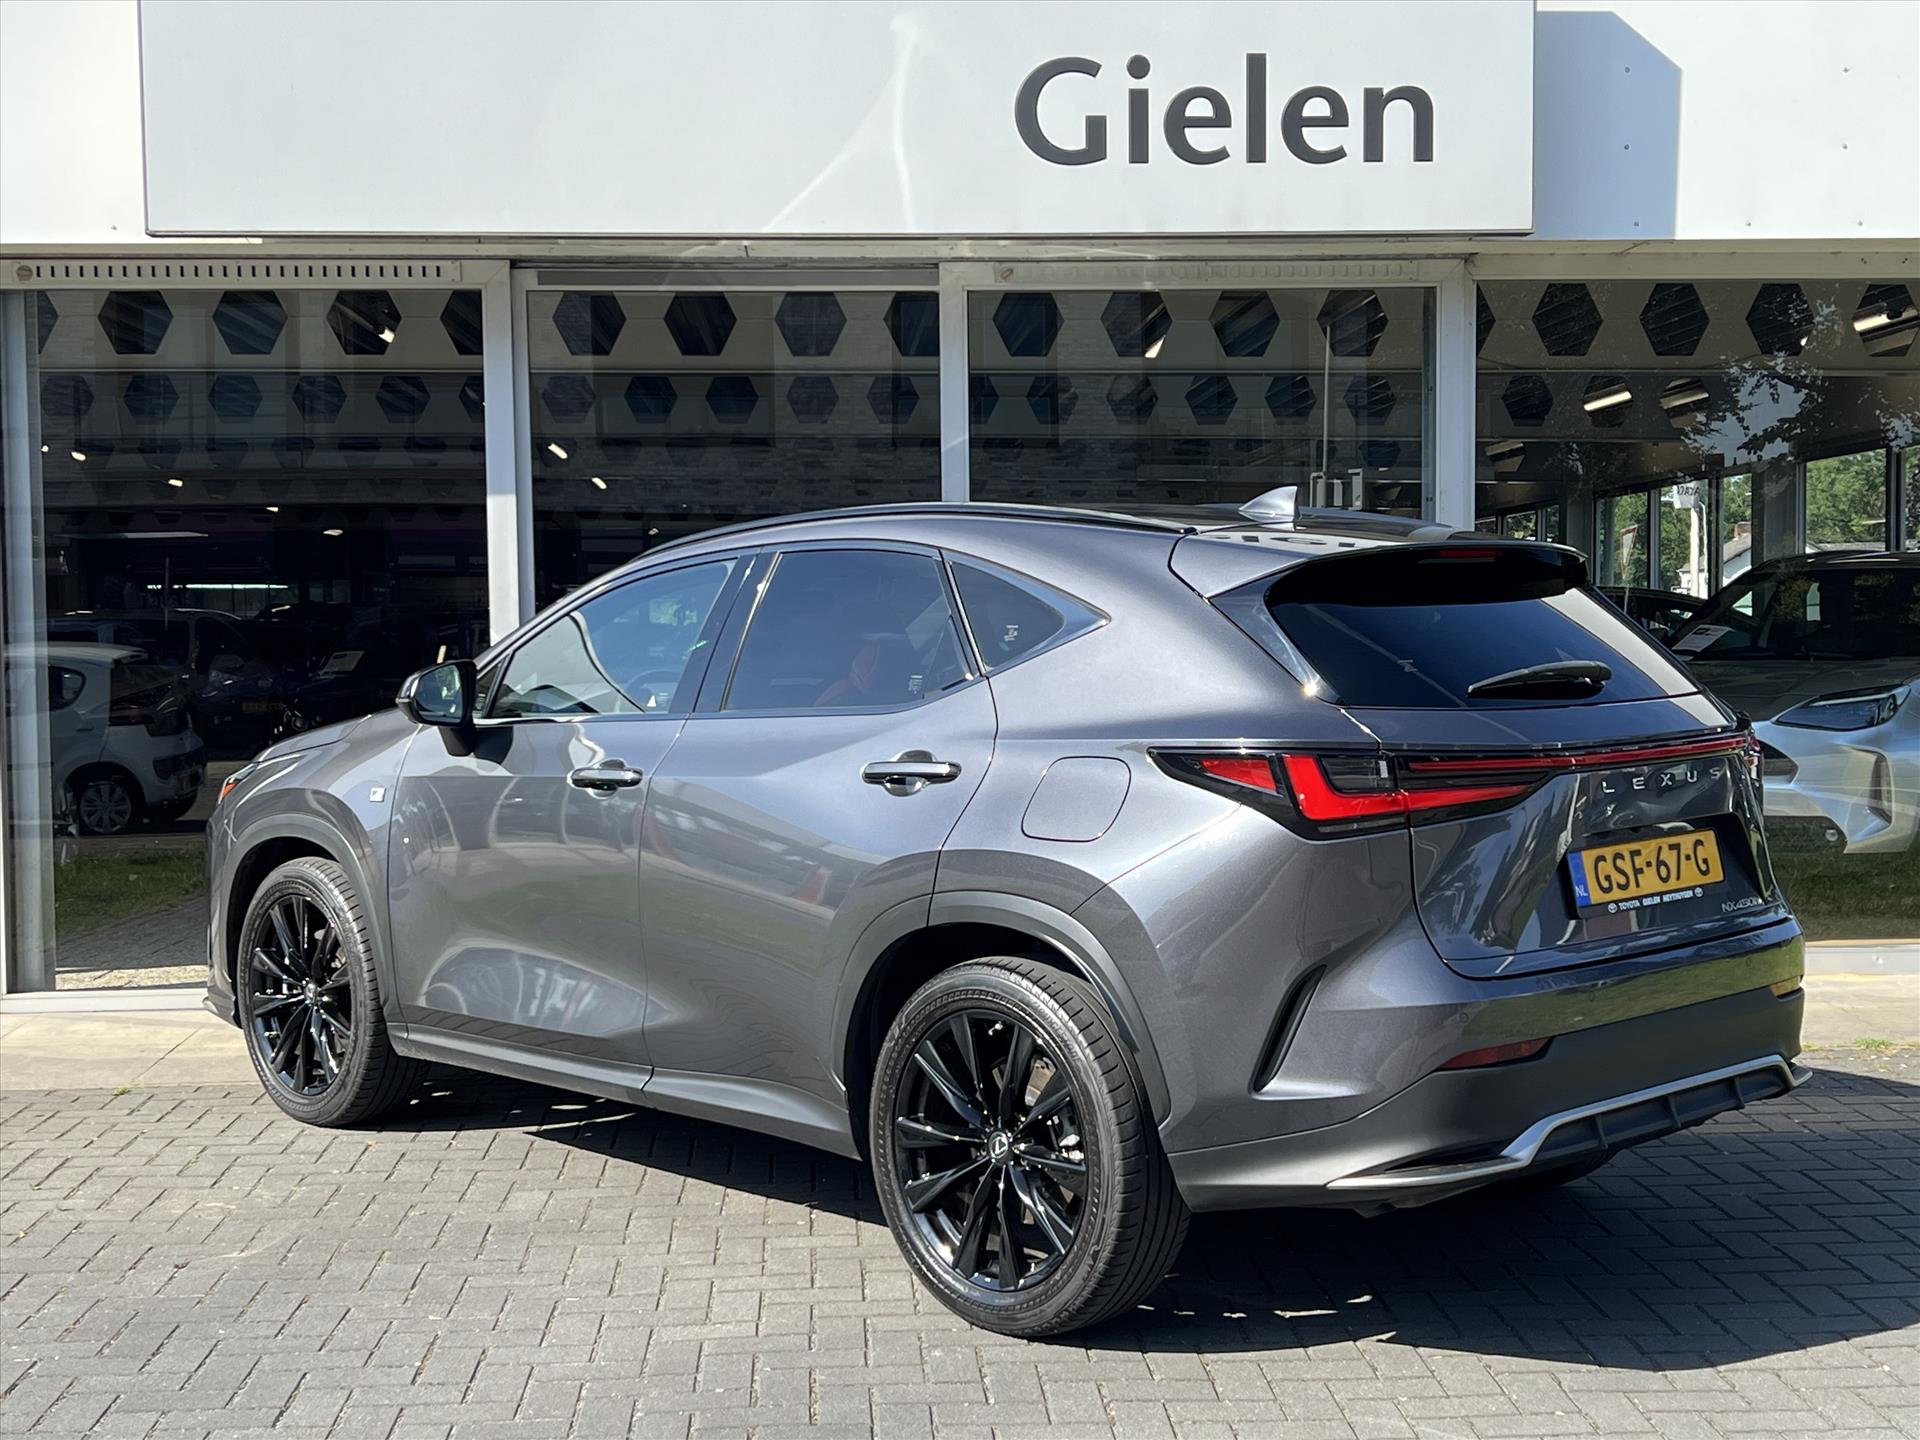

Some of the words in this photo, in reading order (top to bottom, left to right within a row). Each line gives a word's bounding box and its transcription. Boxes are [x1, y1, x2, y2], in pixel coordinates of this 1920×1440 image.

[1014, 53, 1434, 166] Gielen
[1602, 767, 1720, 793] LEXUS
[1594, 838, 1711, 894] GSF-67-G
[1575, 884, 1589, 897] NL
[1618, 899, 1641, 911] TOYOTA
